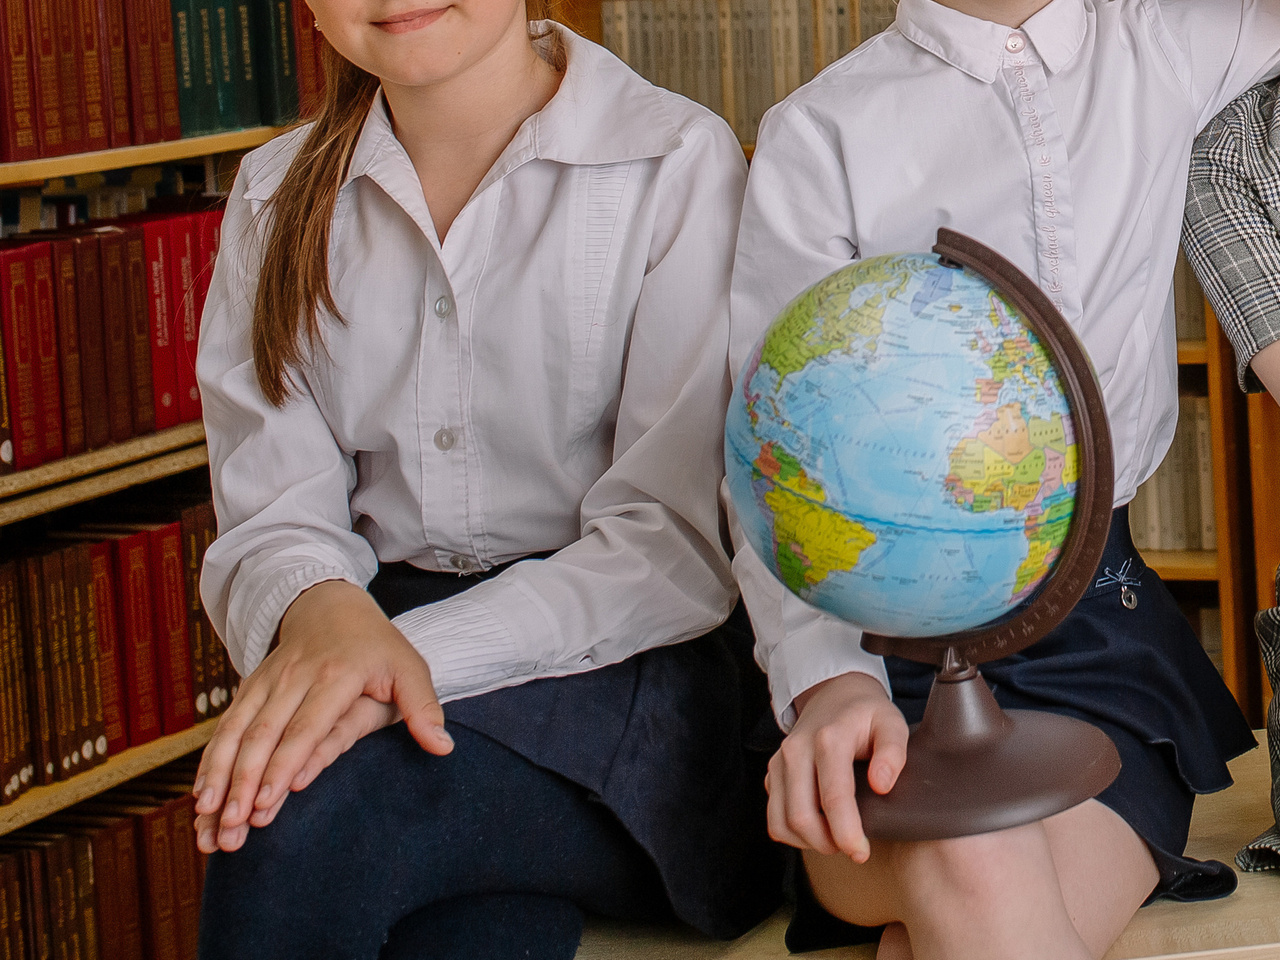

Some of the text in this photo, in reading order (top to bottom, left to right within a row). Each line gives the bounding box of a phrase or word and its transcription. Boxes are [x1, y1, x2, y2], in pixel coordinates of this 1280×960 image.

[1021, 107, 1046, 147] school
[1042, 173, 1061, 219] queen
[1042, 225, 1060, 275] school
